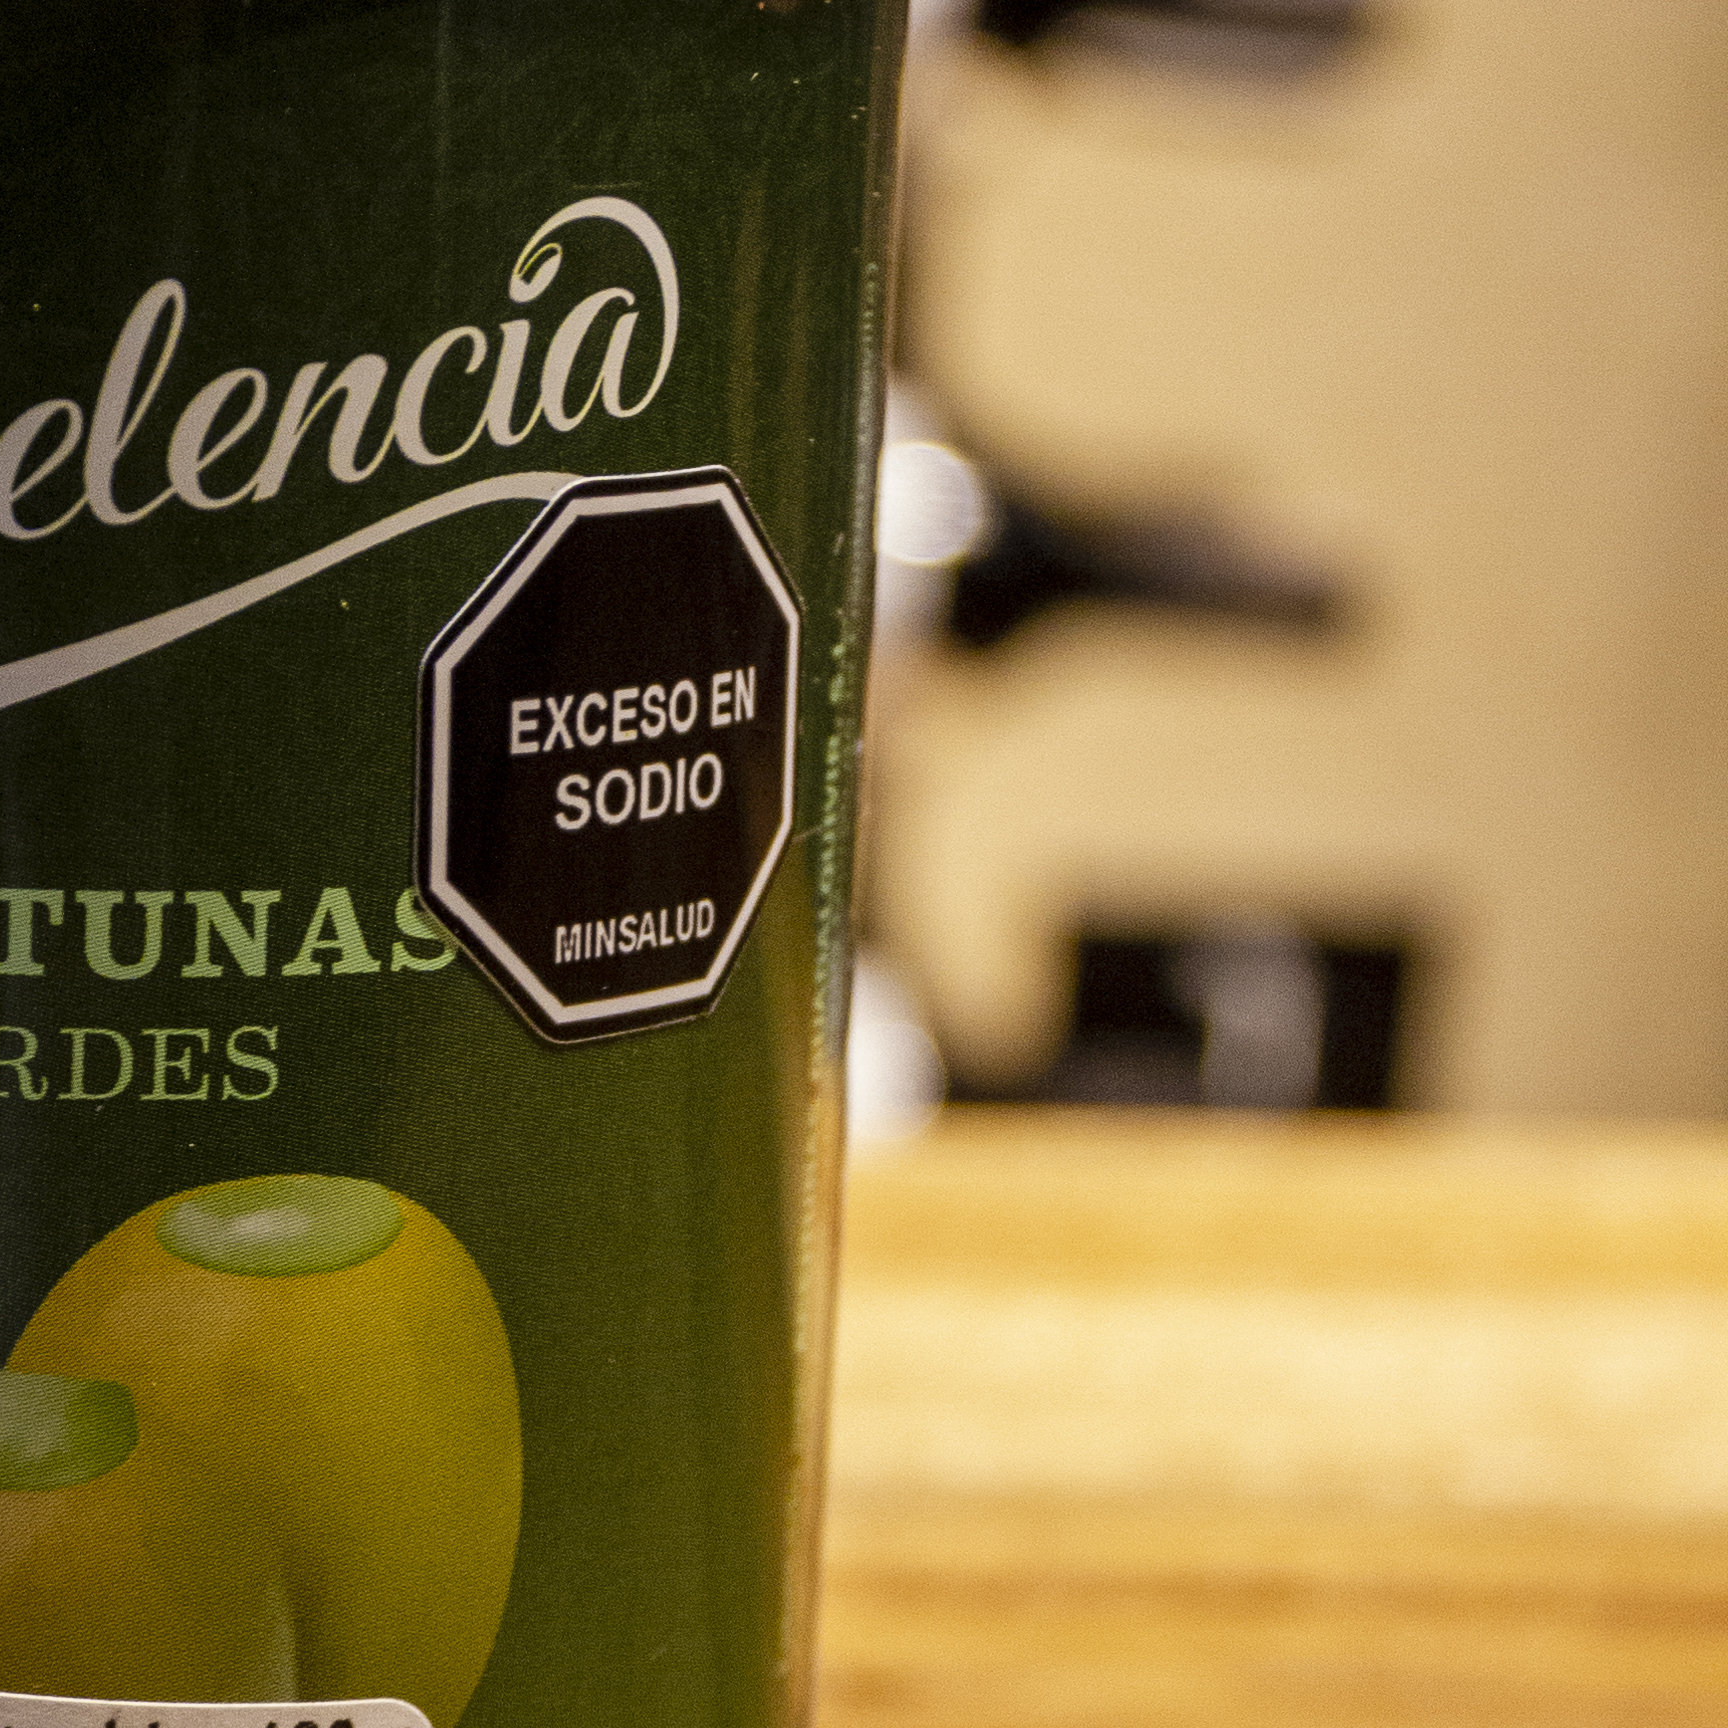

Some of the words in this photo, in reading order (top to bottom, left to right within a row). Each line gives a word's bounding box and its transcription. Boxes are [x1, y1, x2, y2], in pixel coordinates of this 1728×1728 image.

[510, 678, 698, 756] EXCESO
[711, 666, 756, 728] EN
[554, 753, 724, 830] SODIO
[554, 898, 715, 963] MINSALUD
